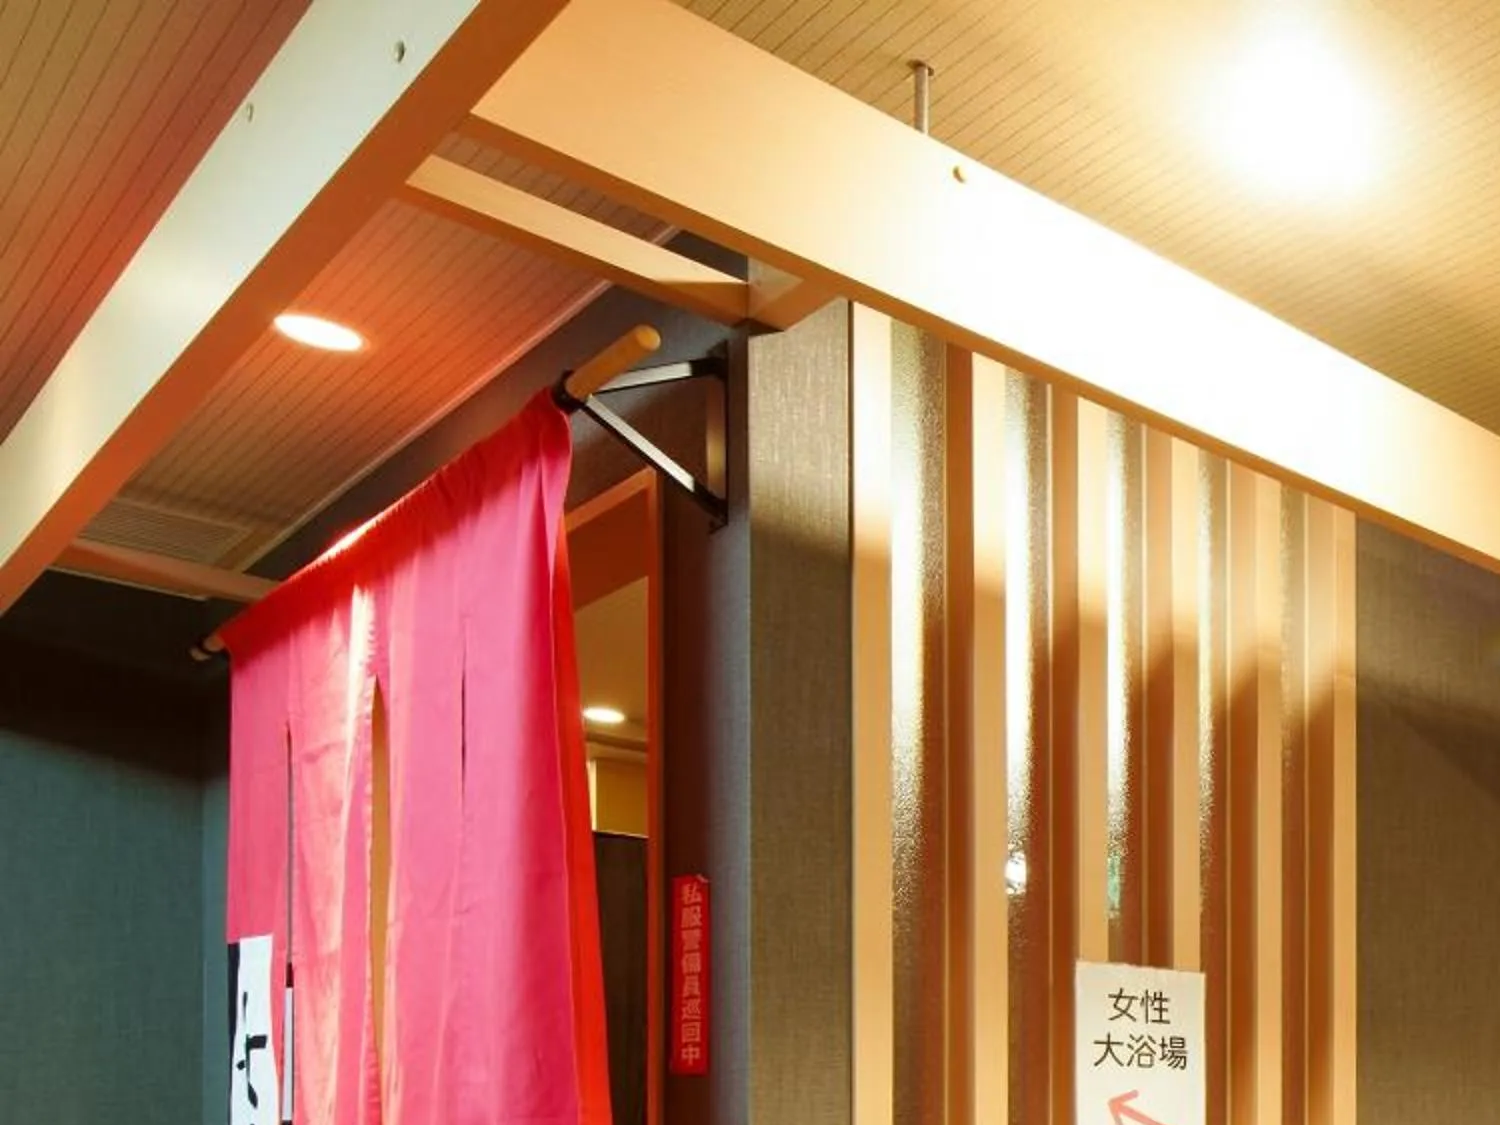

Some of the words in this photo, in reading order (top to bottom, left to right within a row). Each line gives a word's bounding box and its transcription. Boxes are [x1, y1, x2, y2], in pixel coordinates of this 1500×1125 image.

[1108, 987, 1171, 1025] 女性
[1093, 1031, 1188, 1071] 大浴場
